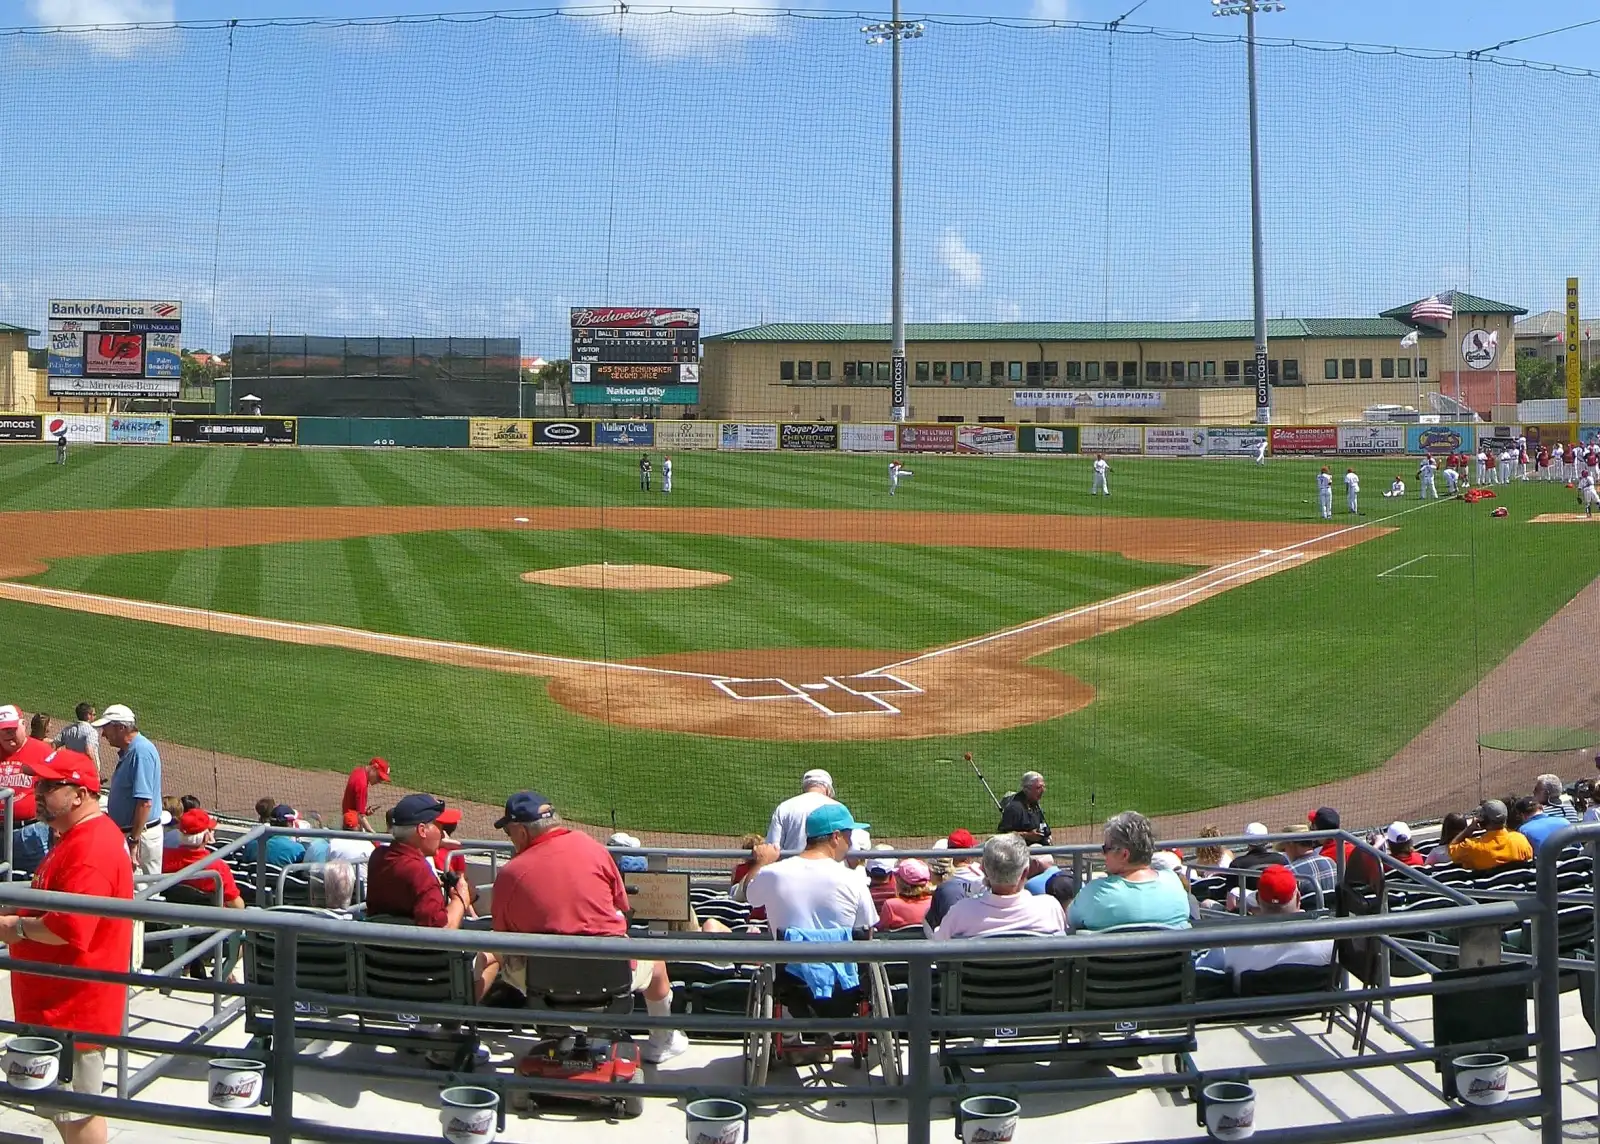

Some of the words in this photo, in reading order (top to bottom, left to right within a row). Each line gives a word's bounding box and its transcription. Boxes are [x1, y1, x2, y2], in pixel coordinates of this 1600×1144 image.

[52, 303, 83, 315] Bank
[84, 303, 94, 315] of
[94, 303, 144, 315] America
[572, 309, 657, 326] Budweiser
[52, 333, 69, 342] ASK
[70, 332, 77, 340] A
[154, 334, 176, 342] 24/7
[52, 340, 79, 350] LOCAL
[1256, 354, 1267, 403] comcast
[89, 380, 160, 390] Mercedes-Benz
[606, 387, 646, 395] National
[647, 387, 666, 397] City
[233, 426, 244, 434] THE
[244, 426, 264, 434] SHOW
[602, 423, 627, 433] Mallory
[628, 423, 648, 432] Creek
[784, 425, 812, 434] Roger
[811, 425, 834, 434] Dean
[494, 432, 528, 440] LANDSHARK
[1273, 429, 1296, 440] Elite
[1345, 440, 1372, 448] Island
[1376, 440, 1399, 448] Grill
